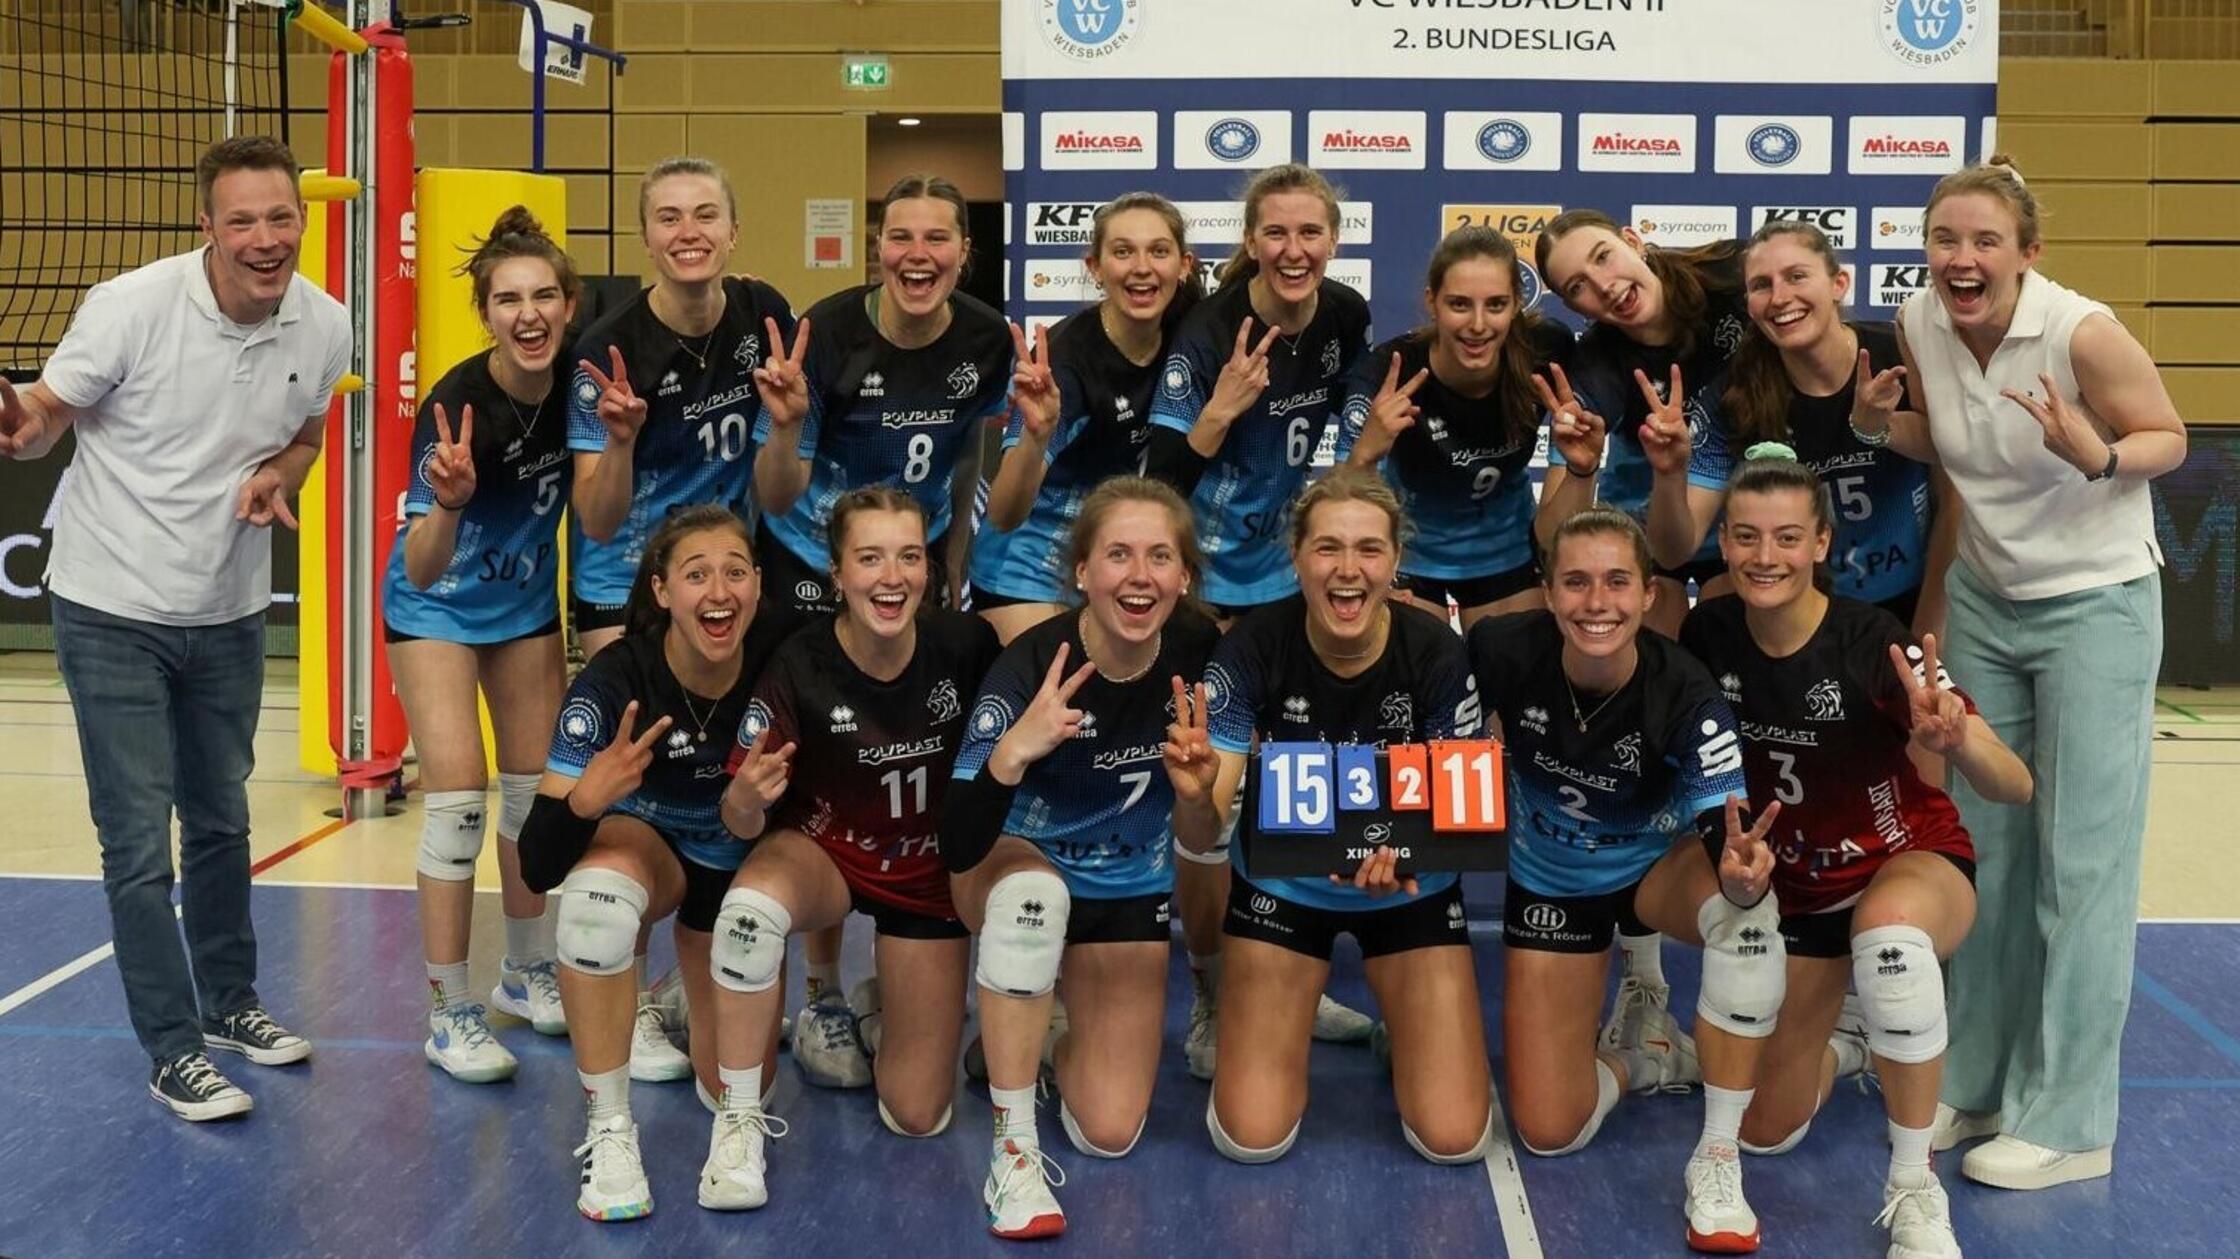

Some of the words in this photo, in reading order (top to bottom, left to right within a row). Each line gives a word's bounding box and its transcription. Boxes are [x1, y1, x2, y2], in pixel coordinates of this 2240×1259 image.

[1053, 32, 1129, 59] WIESBADEN
[1393, 28, 1417, 49] 2.
[1426, 28, 1616, 51] BUNDESLIGA
[1891, 38, 1967, 65] WIESBADEN
[1055, 130, 1142, 148] MIKASA
[1323, 129, 1411, 147] MIKASA
[1592, 133, 1681, 151] MIKASA
[1863, 136, 1950, 154] MIKASA
[1660, 219, 1727, 233] syracom
[882, 409, 955, 423] POLYPLAST
[698, 413, 747, 462] 10
[1286, 417, 1310, 467] 6
[904, 433, 934, 483] 8
[1806, 451, 1875, 472] OLYPLAST
[531, 471, 561, 516] 5
[1470, 466, 1501, 500] 9
[858, 735, 942, 760] POLYPLAST
[1094, 742, 1168, 765] POLYPLAS
[1269, 754, 1328, 826] 15
[1348, 767, 1374, 805] 3
[1397, 767, 1422, 805] 2
[1442, 752, 1495, 825] 11
[1769, 750, 1804, 805] 3
[880, 766, 928, 819] 11
[1119, 771, 1151, 815] 7
[1558, 785, 1600, 822] 2
